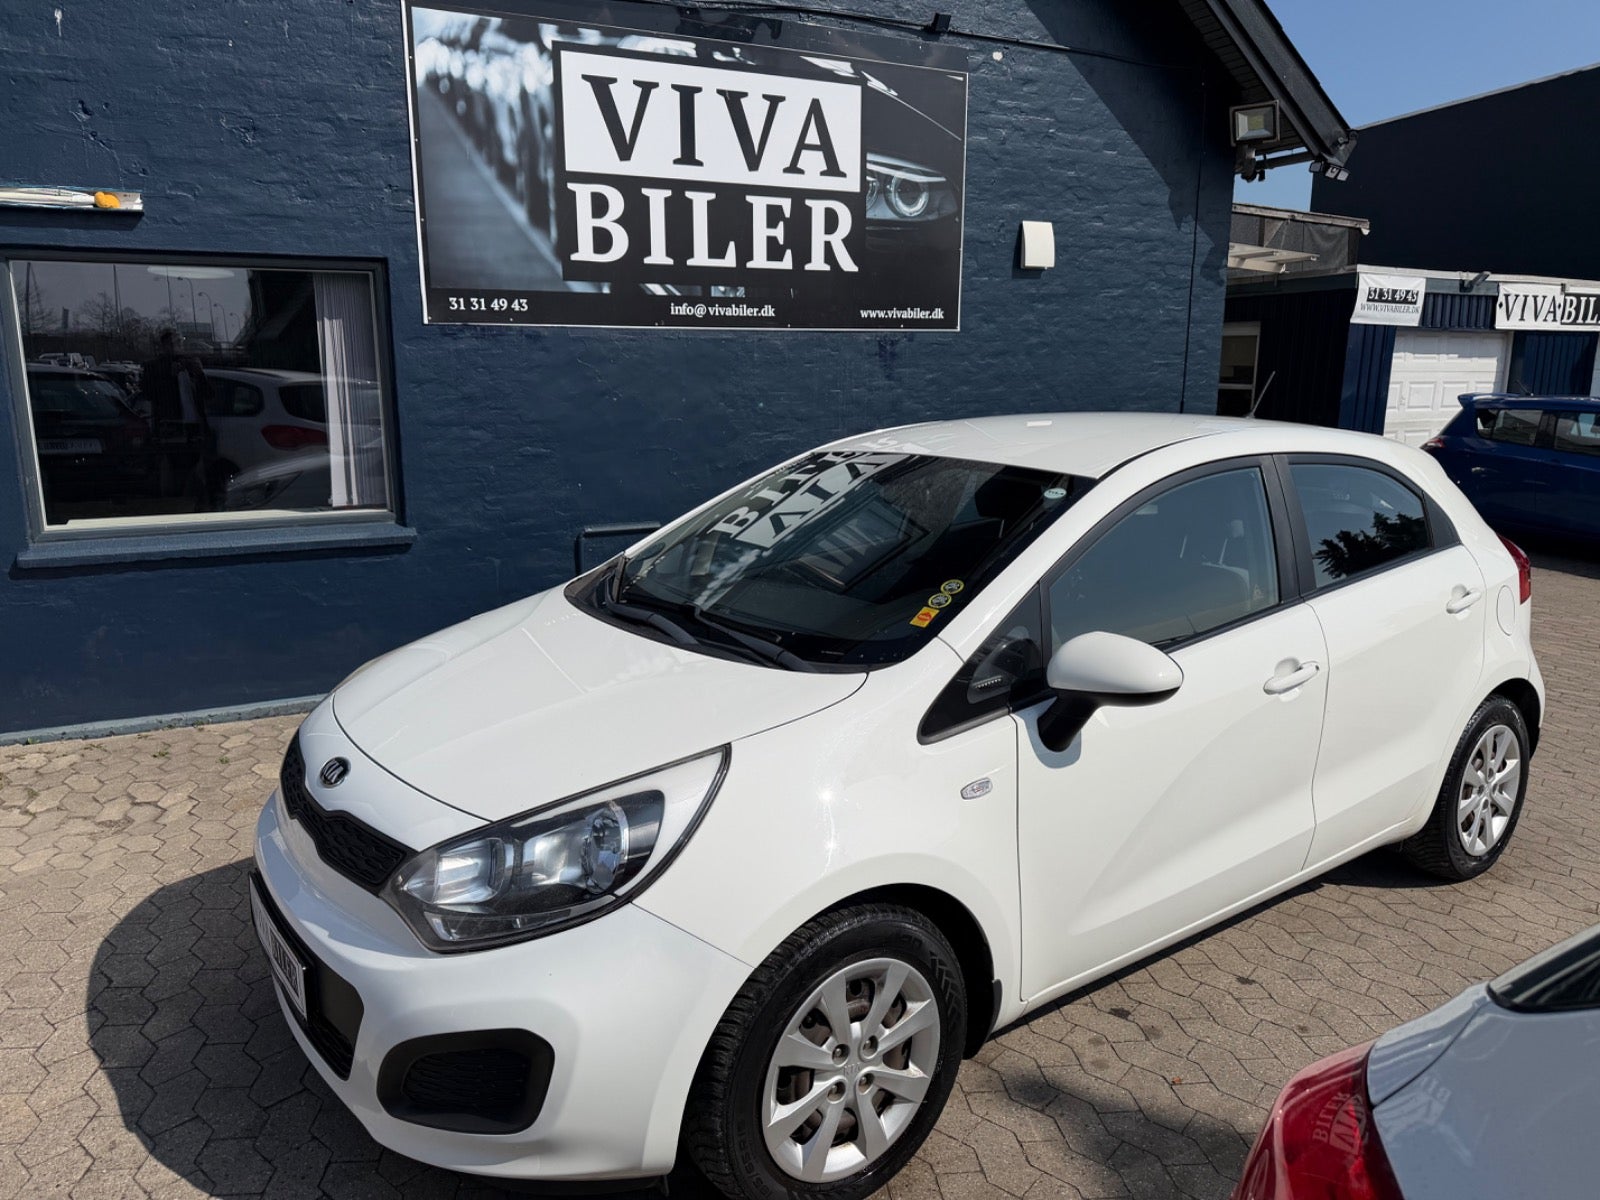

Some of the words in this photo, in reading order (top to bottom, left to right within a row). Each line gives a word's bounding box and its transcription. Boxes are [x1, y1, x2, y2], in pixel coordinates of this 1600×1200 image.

[581, 73, 847, 178] VIVA
[566, 182, 859, 273] BILER
[1368, 286, 1380, 300] 31
[1381, 288, 1393, 301] 31
[1394, 289, 1406, 302] 49
[448, 297, 466, 311] 31
[469, 297, 487, 311] 31
[490, 298, 508, 311] 49
[511, 299, 529, 312] 43
[670, 303, 776, 318] info@vivabiler.dk
[1503, 293, 1558, 323] VIVA
[1561, 295, 1600, 325] BIL
[859, 307, 945, 319] www.vivabiler.dk
